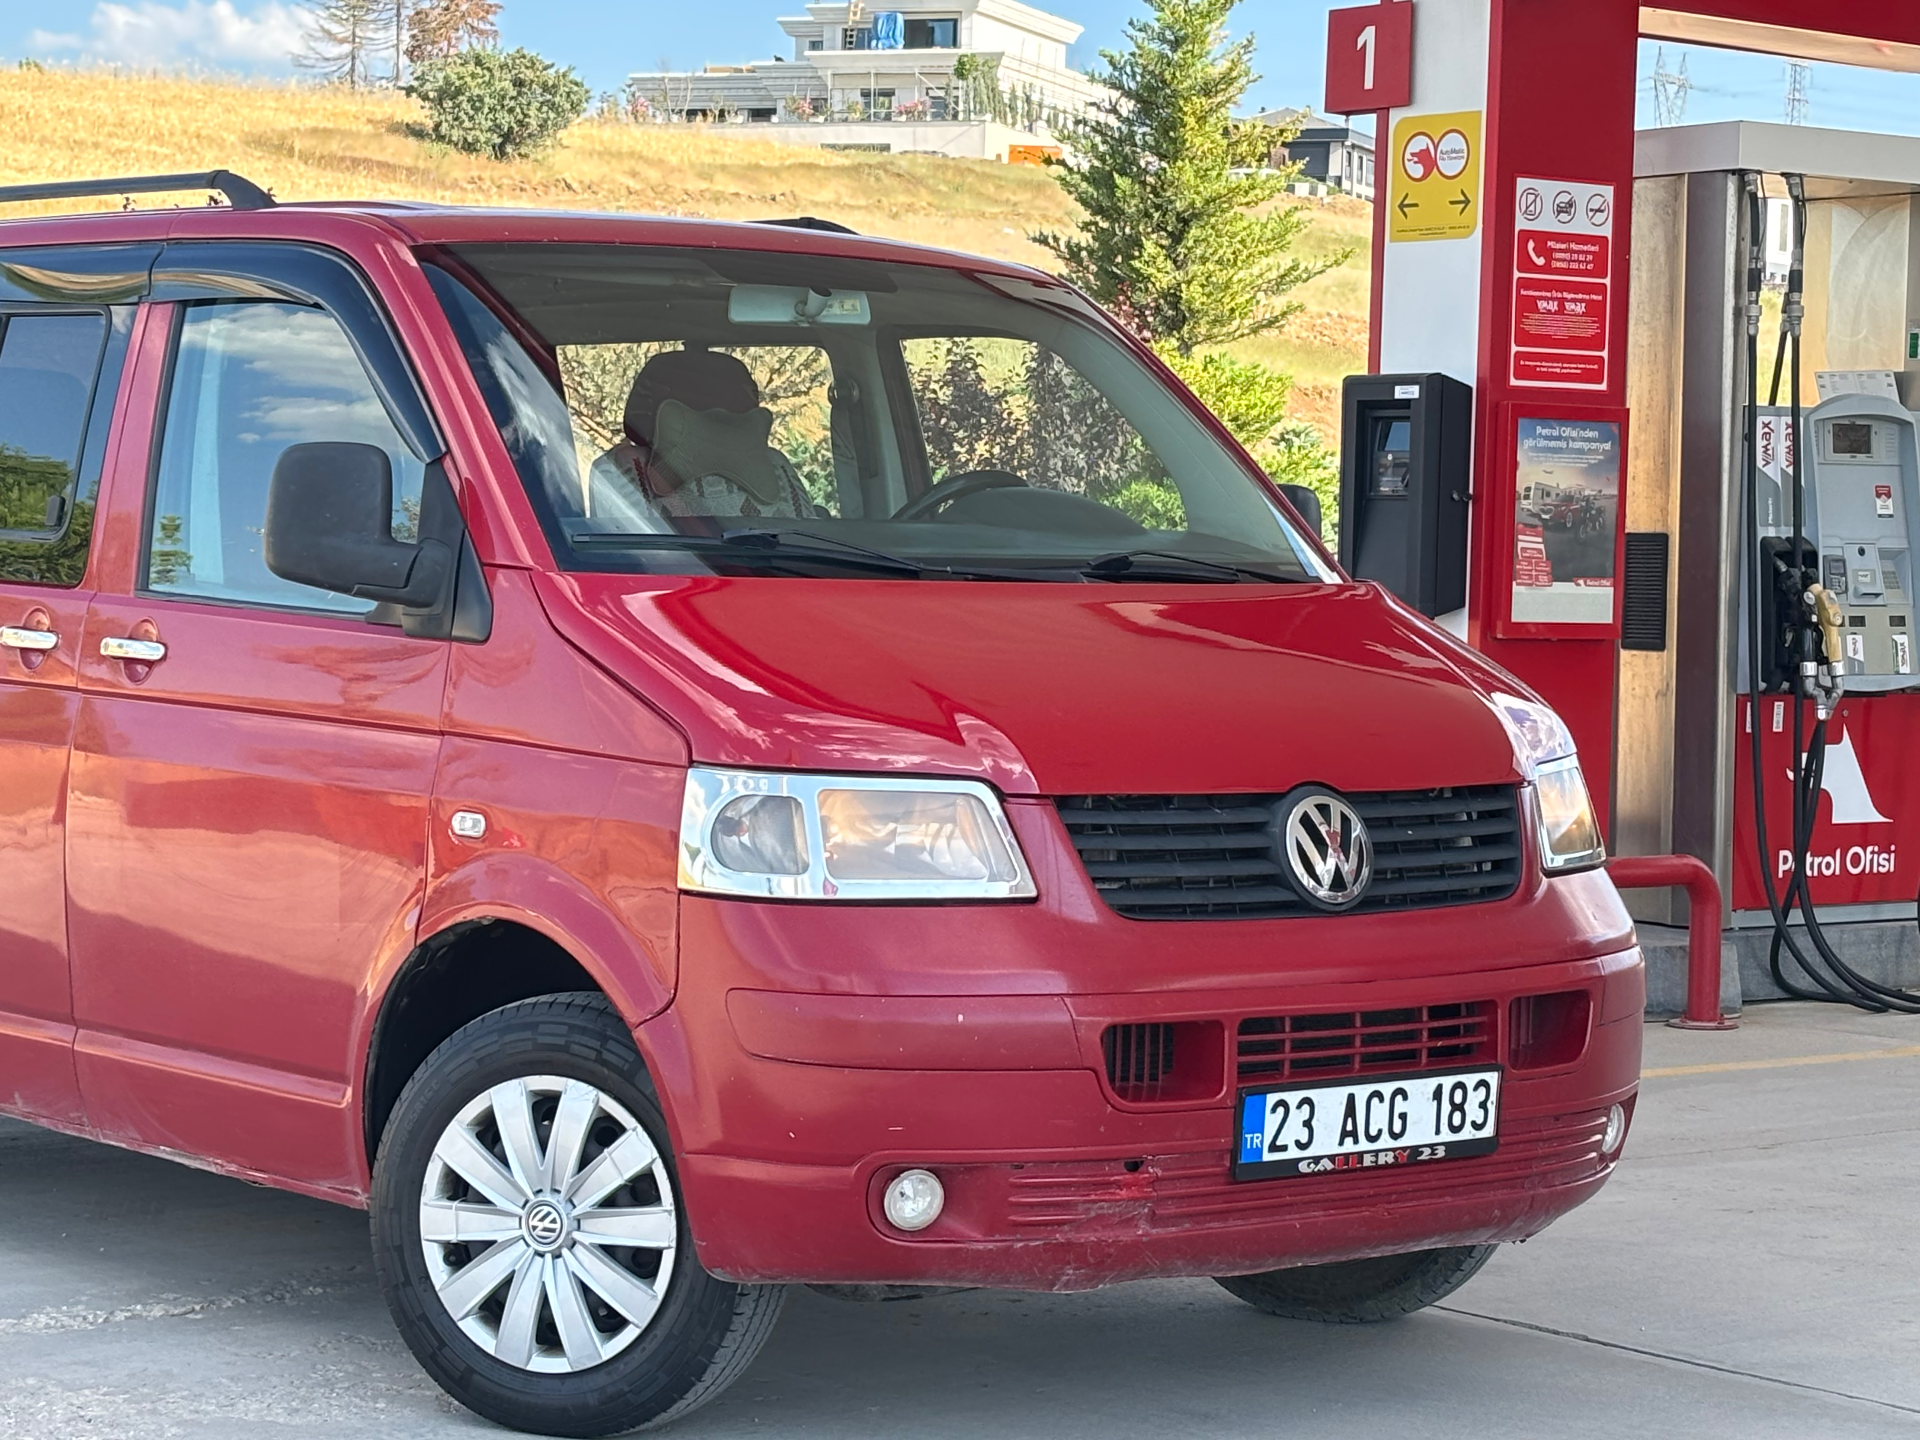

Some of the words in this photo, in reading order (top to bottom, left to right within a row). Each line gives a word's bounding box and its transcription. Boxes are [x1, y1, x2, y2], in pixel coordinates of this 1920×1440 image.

[1356, 25, 1376, 90] 1
[1536, 425, 1559, 437] Petrol
[1778, 847, 1841, 879] Ptrol
[1845, 844, 1896, 875] Ofisi
[1267, 1096, 1316, 1154] 23
[1338, 1086, 1409, 1147] ACG
[1432, 1078, 1492, 1137] 183
[1244, 1133, 1263, 1150] TR
[1297, 1147, 1411, 1174] GALLERY
[1416, 1145, 1447, 1161] 23
